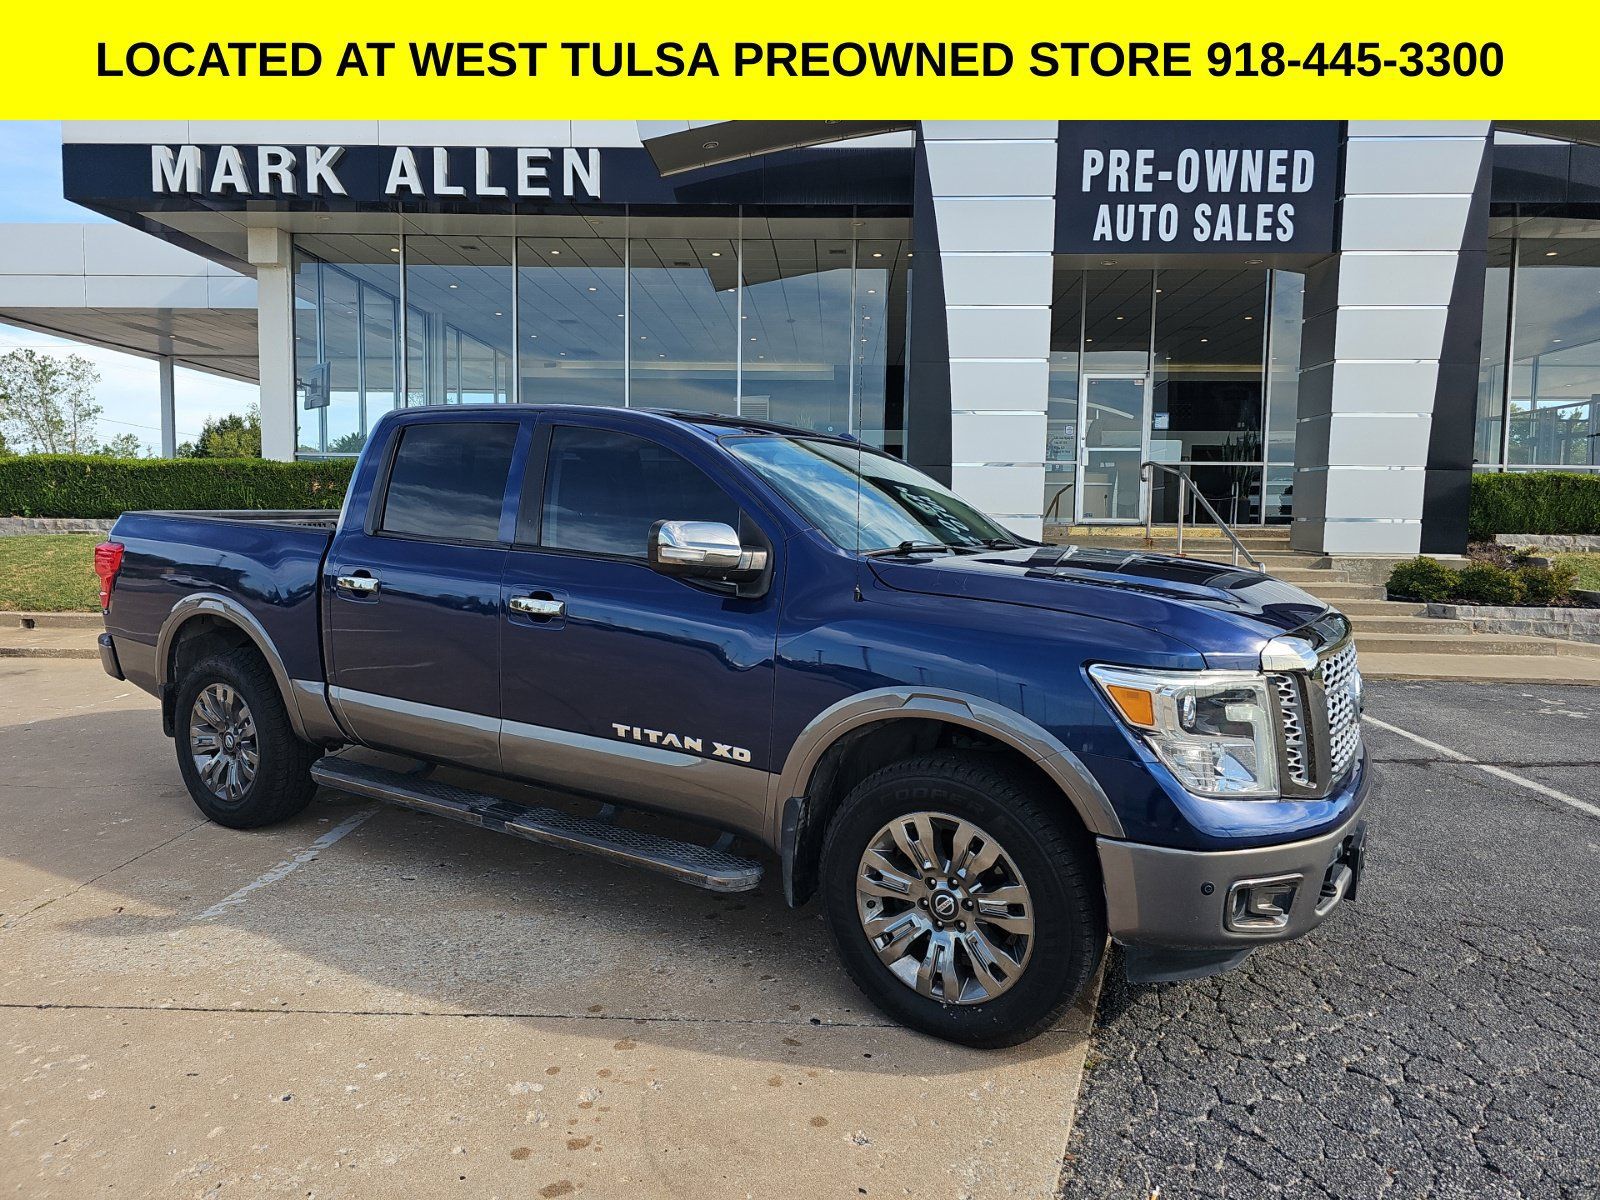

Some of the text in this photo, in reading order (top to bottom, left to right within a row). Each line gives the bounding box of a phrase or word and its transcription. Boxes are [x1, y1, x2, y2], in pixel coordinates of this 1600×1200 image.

[151, 145, 600, 199] MARK ALLEN
[1082, 148, 1314, 194] PRE-OWNED
[1093, 203, 1295, 242] AUTO SALES
[612, 722, 752, 763] TITAN XD
